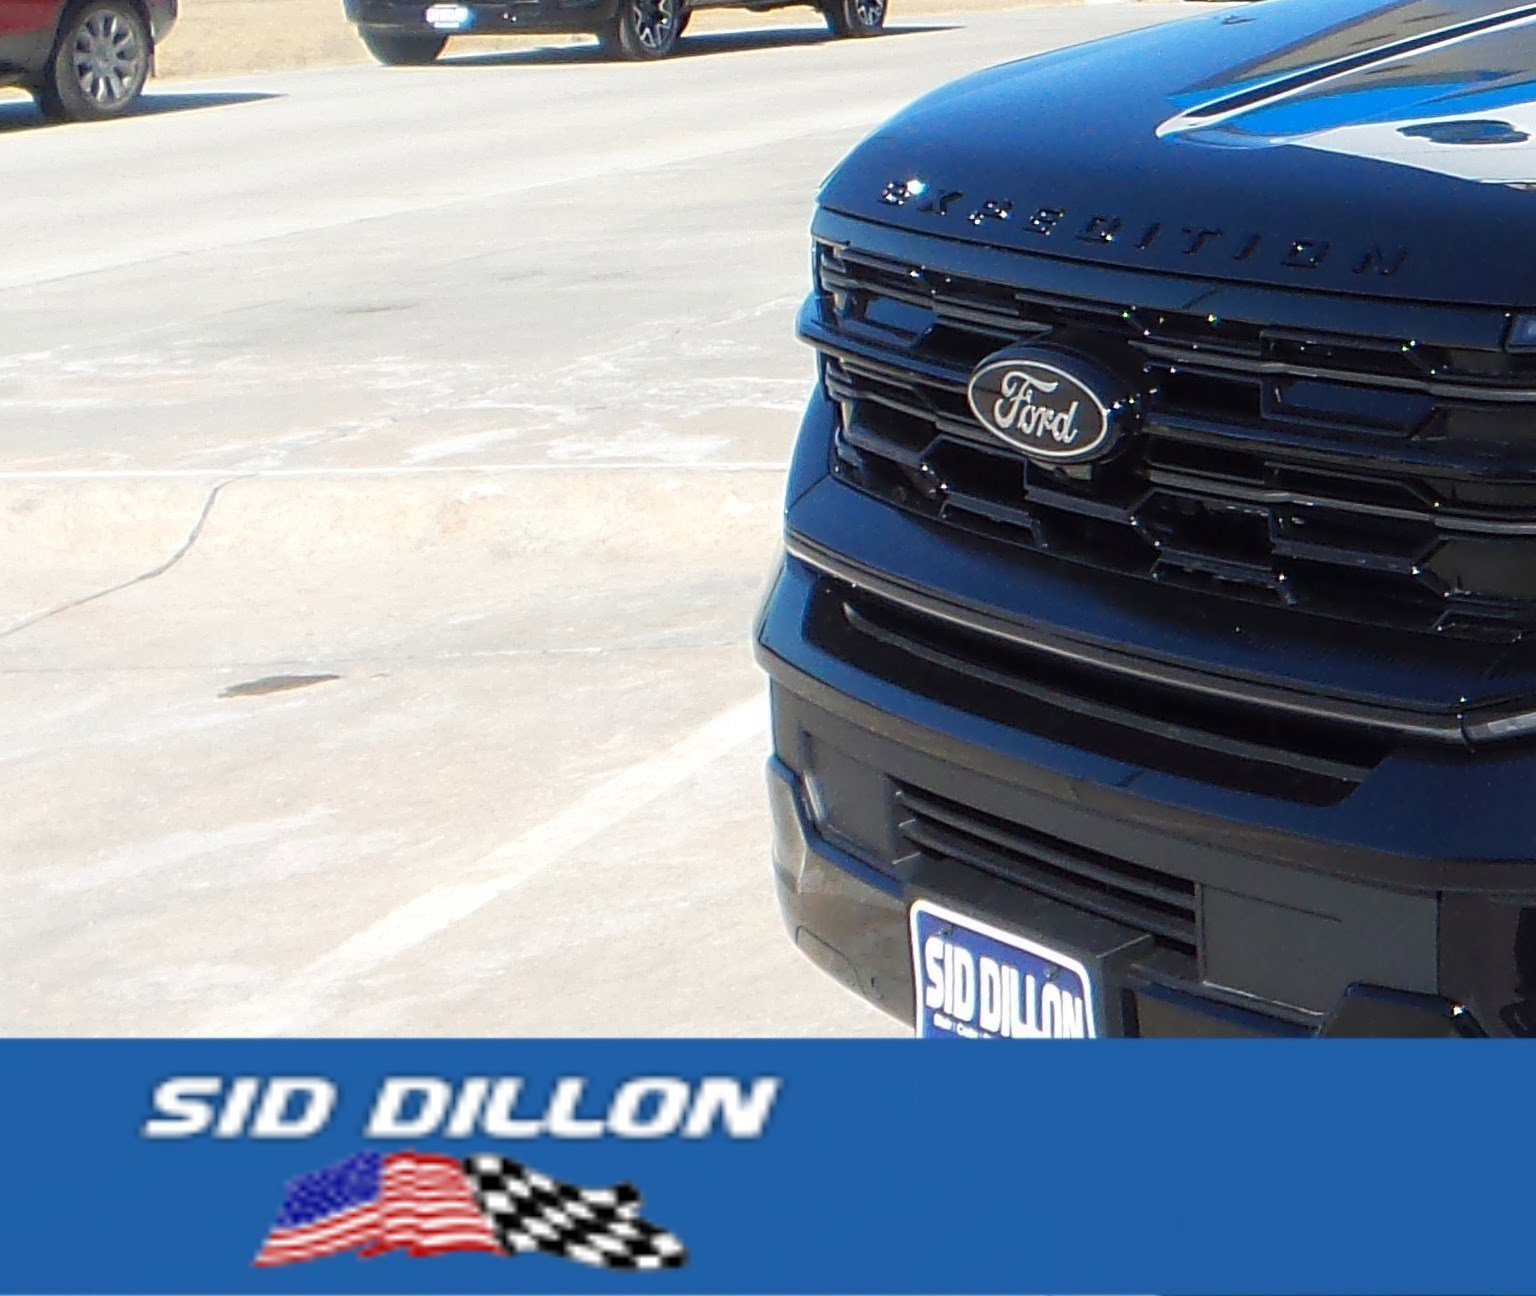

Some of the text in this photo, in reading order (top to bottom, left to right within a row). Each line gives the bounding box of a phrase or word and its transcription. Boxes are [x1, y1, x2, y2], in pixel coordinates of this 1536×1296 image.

[877, 178, 1410, 277] EXPEDITION
[993, 371, 1079, 443] Ford
[925, 936, 1084, 1038] SID DILLON
